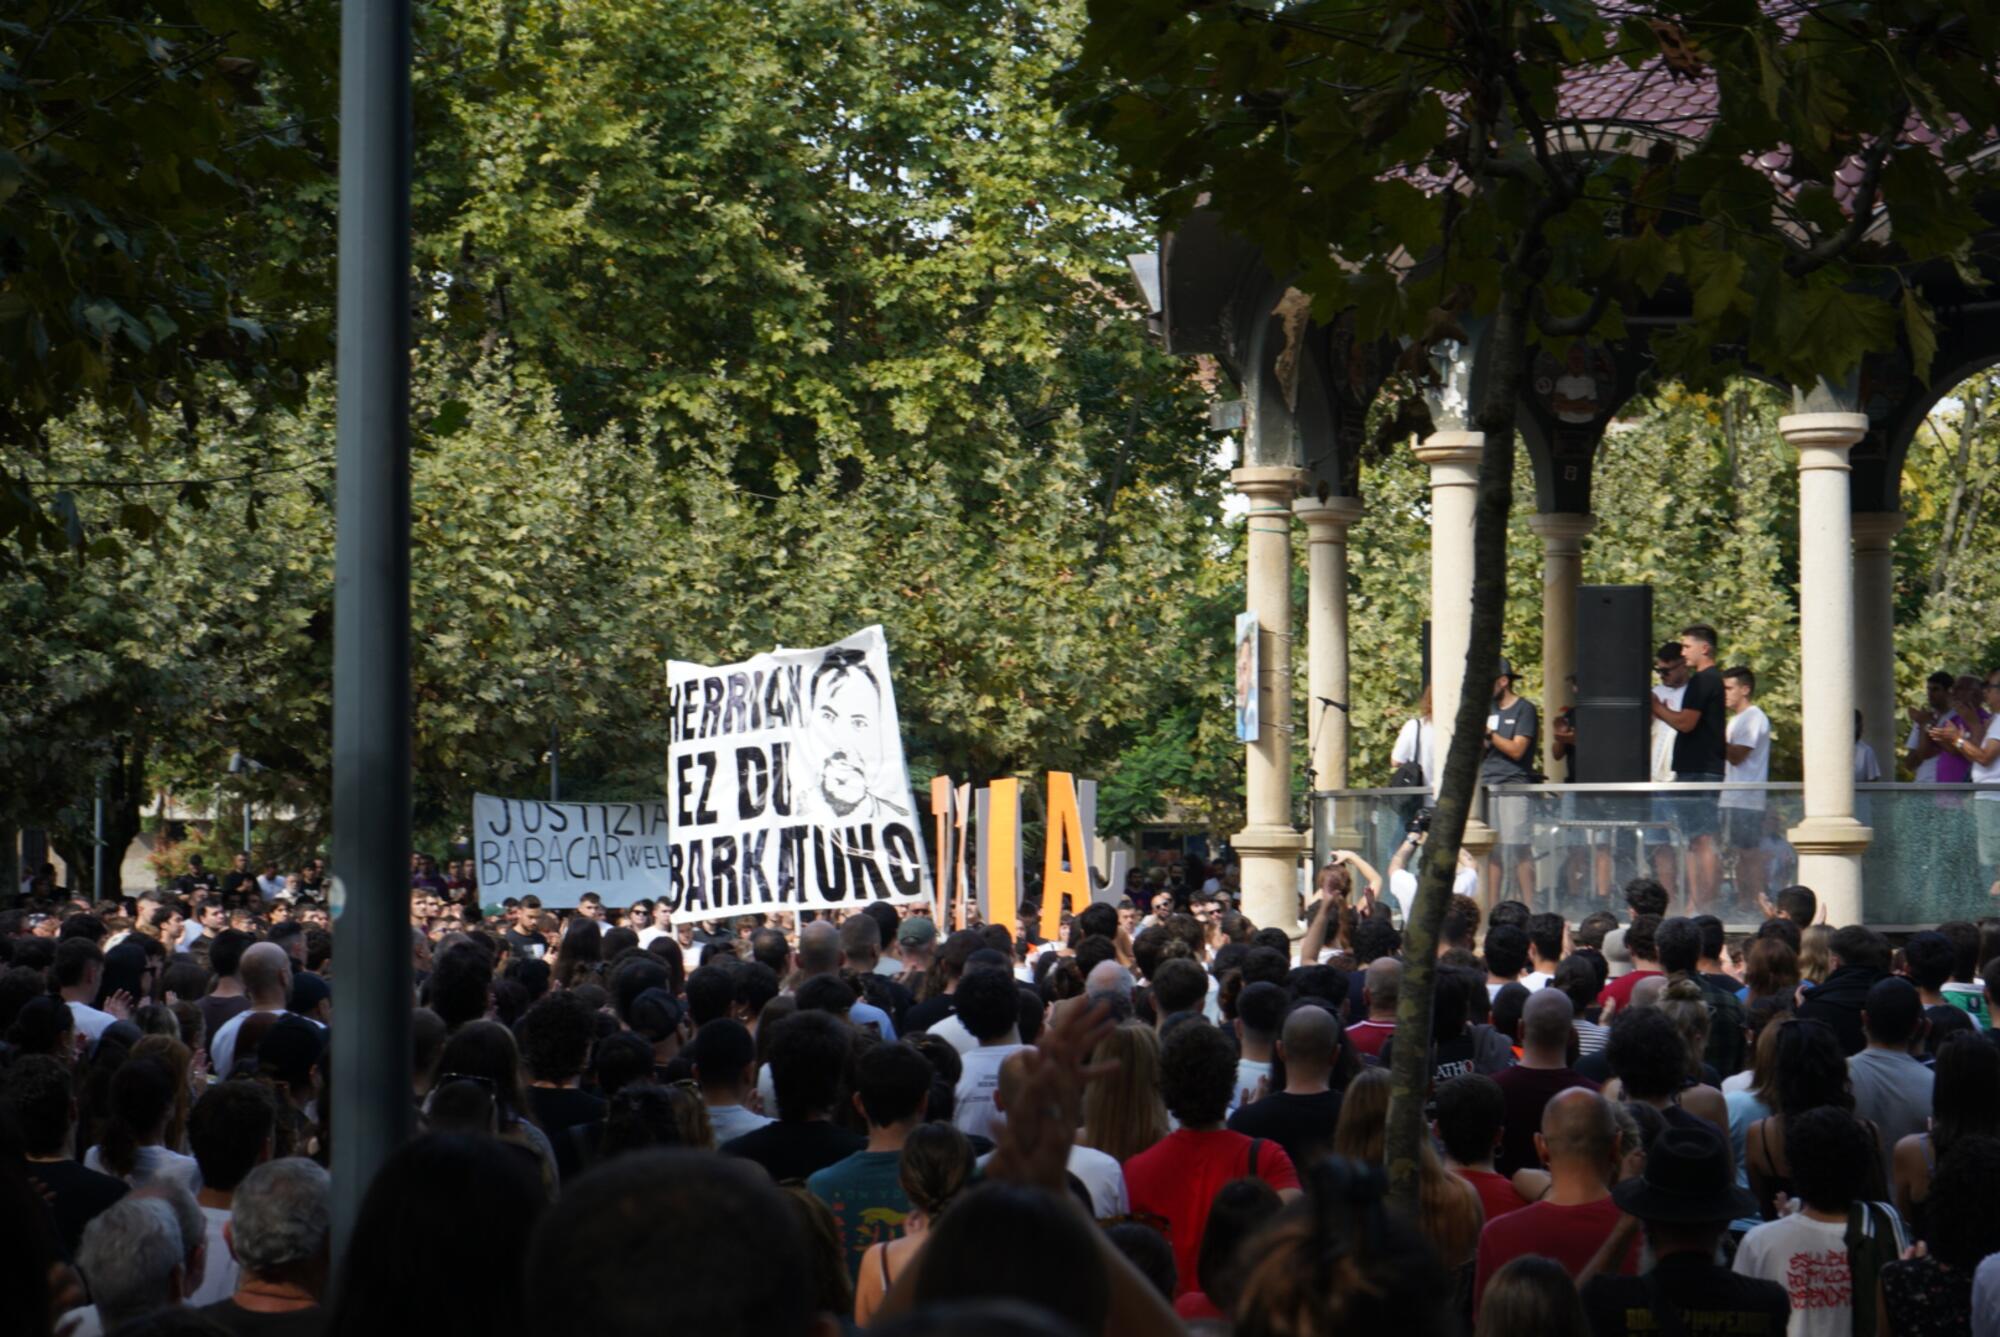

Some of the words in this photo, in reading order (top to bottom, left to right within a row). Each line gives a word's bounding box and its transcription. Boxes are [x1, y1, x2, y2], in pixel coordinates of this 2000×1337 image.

[488, 799, 669, 836] JUSTIZIA
[677, 751, 718, 827] EZ
[735, 742, 792, 820] DU
[480, 835, 625, 886] BABACAR
[669, 822, 922, 914] BARKATUKO
